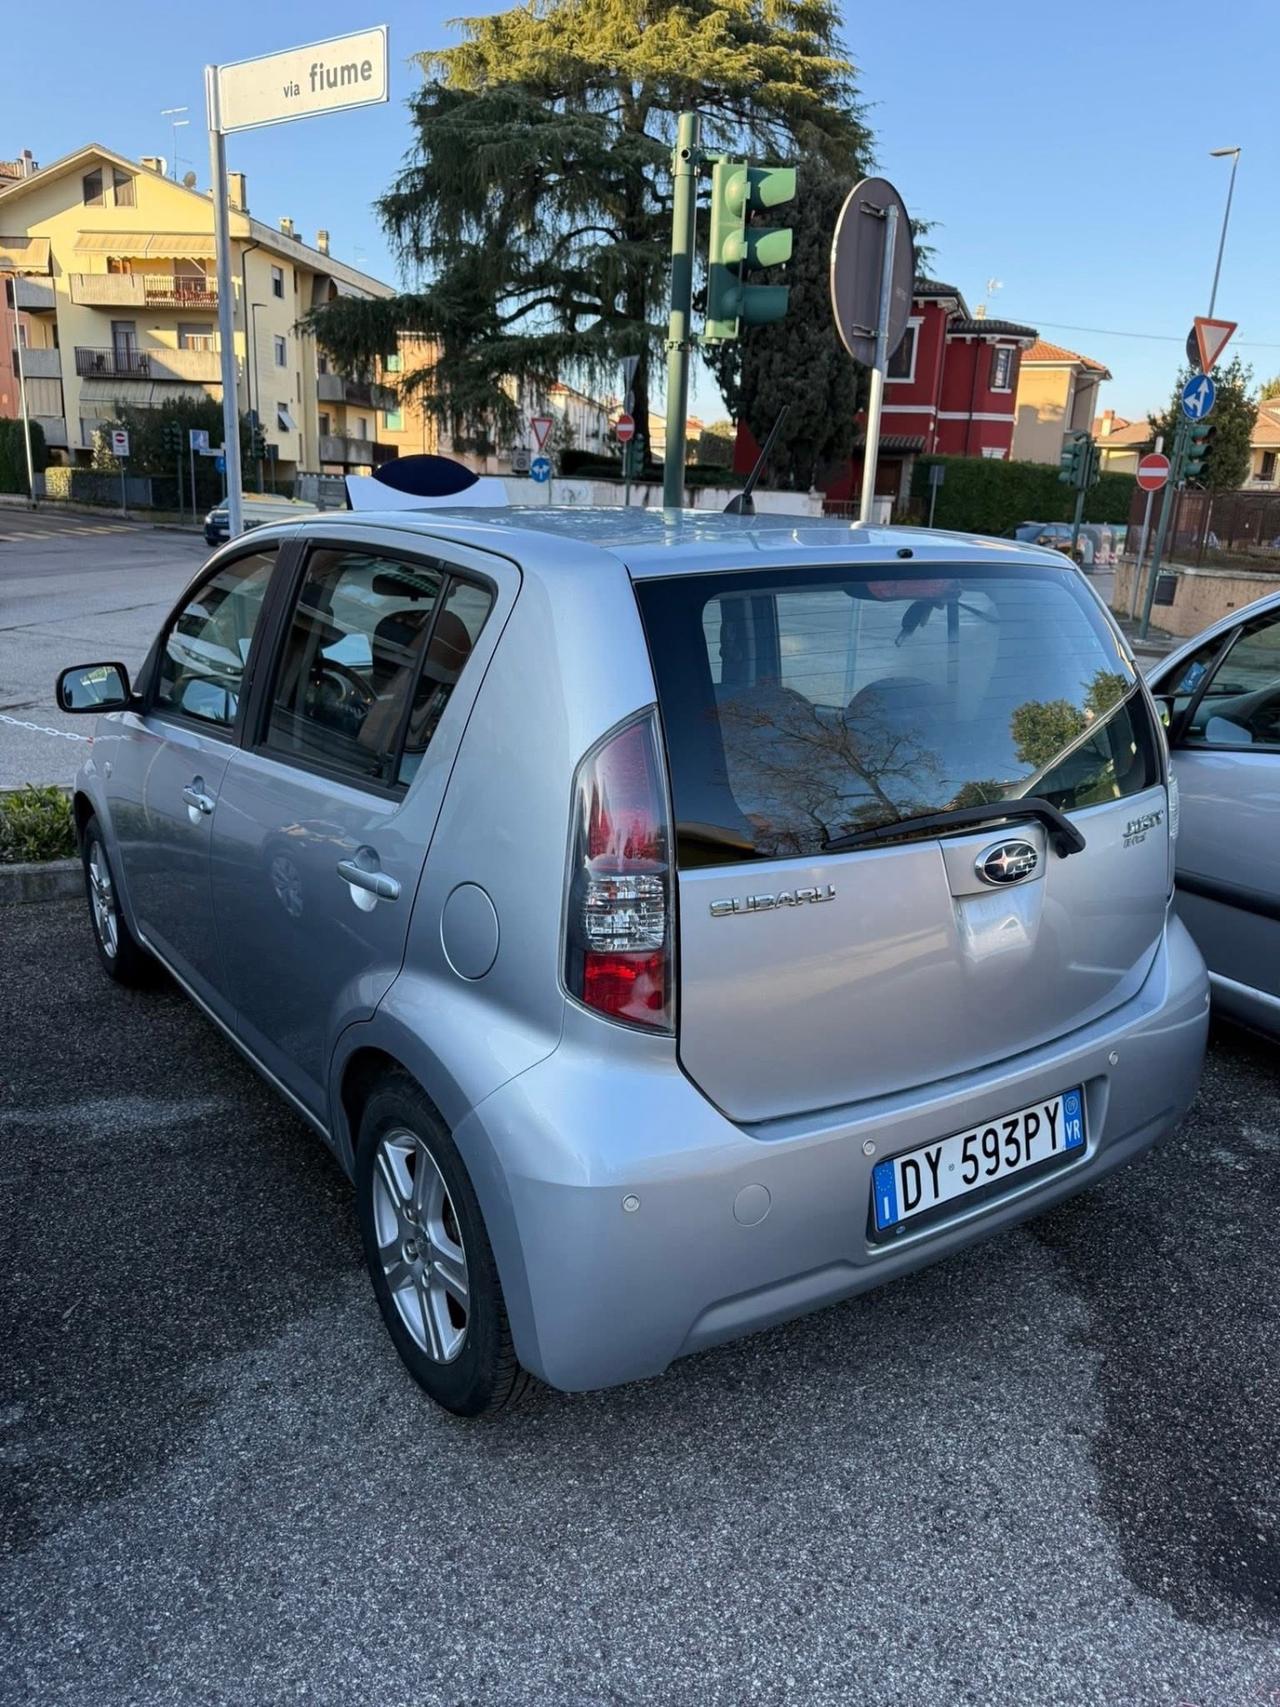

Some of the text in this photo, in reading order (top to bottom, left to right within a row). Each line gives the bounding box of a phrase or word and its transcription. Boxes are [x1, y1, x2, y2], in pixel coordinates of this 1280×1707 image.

[283, 59, 372, 98] via fiume
[710, 883, 836, 917] SUBARU
[1065, 1119, 1081, 1142] VR
[900, 1101, 1060, 1213] DY 593PY
[883, 1196, 890, 1220] I
